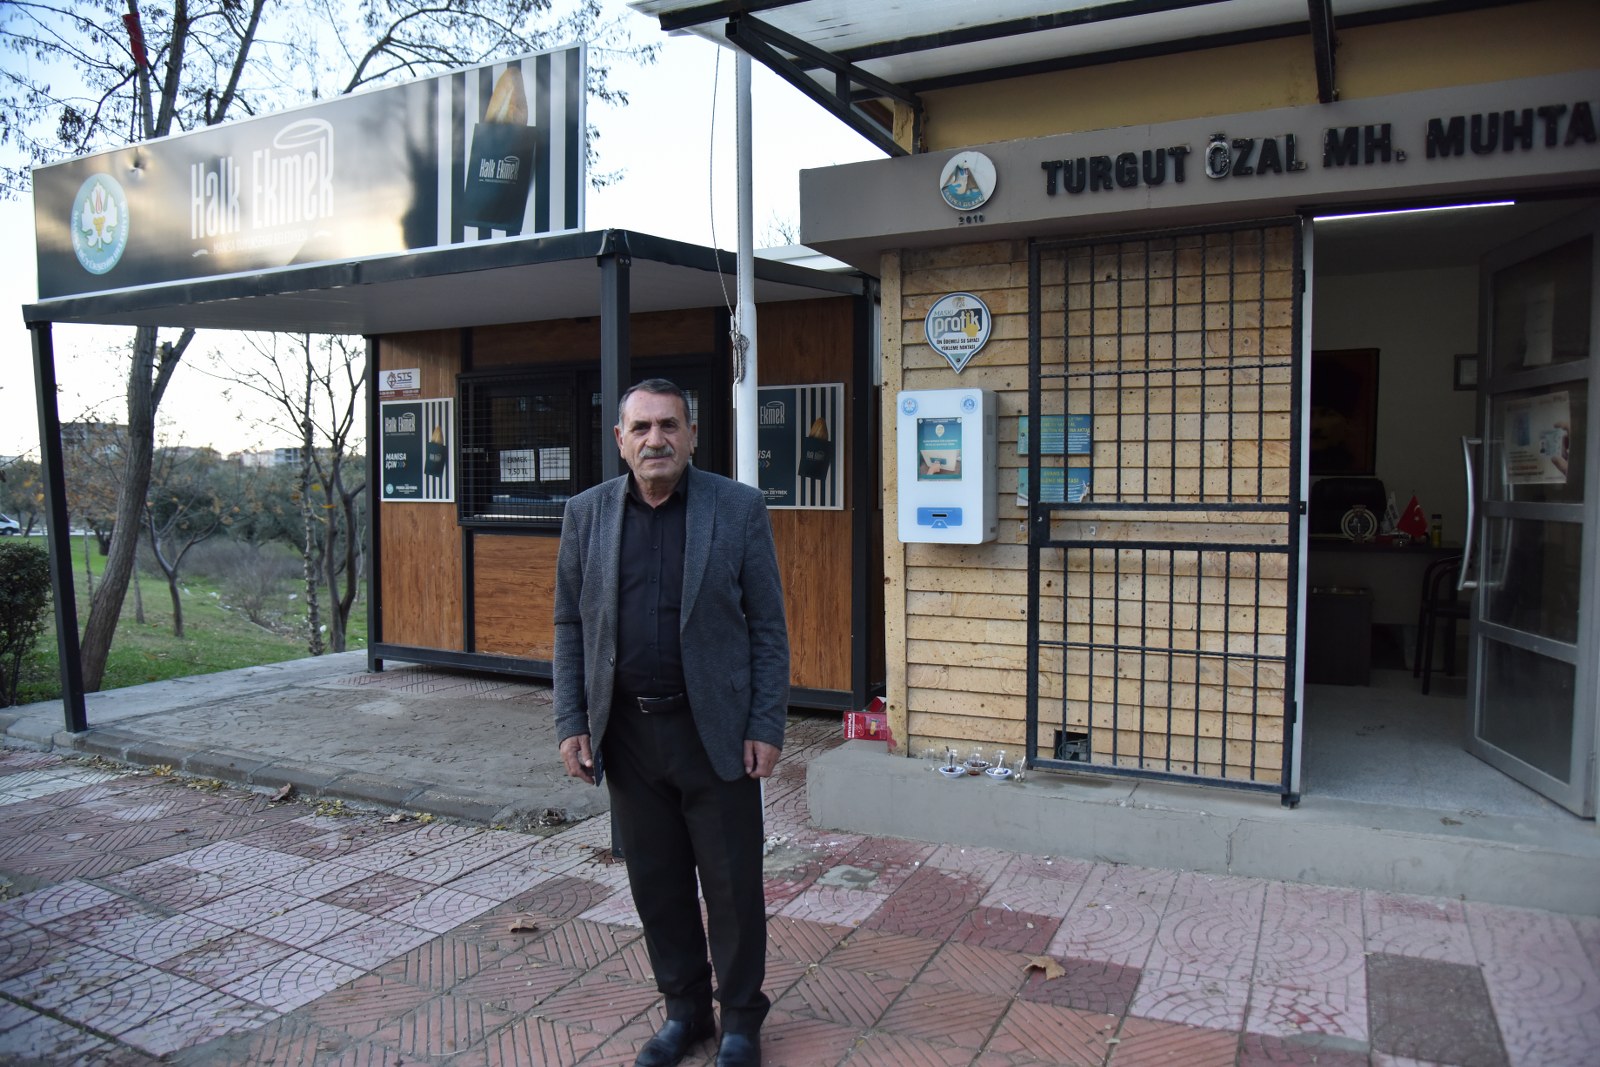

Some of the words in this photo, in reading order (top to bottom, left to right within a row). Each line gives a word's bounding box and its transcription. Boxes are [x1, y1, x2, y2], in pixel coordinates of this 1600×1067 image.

[479, 158, 496, 178] Halk
[1041, 143, 1192, 196] TURGUT
[1205, 132, 1308, 180] ÖZAL
[1322, 123, 1408, 168] MH.
[1426, 101, 1597, 160] MUHTA
[191, 156, 240, 240] Halk
[252, 118, 335, 229] Ekmek
[759, 400, 786, 425] Ekmek
